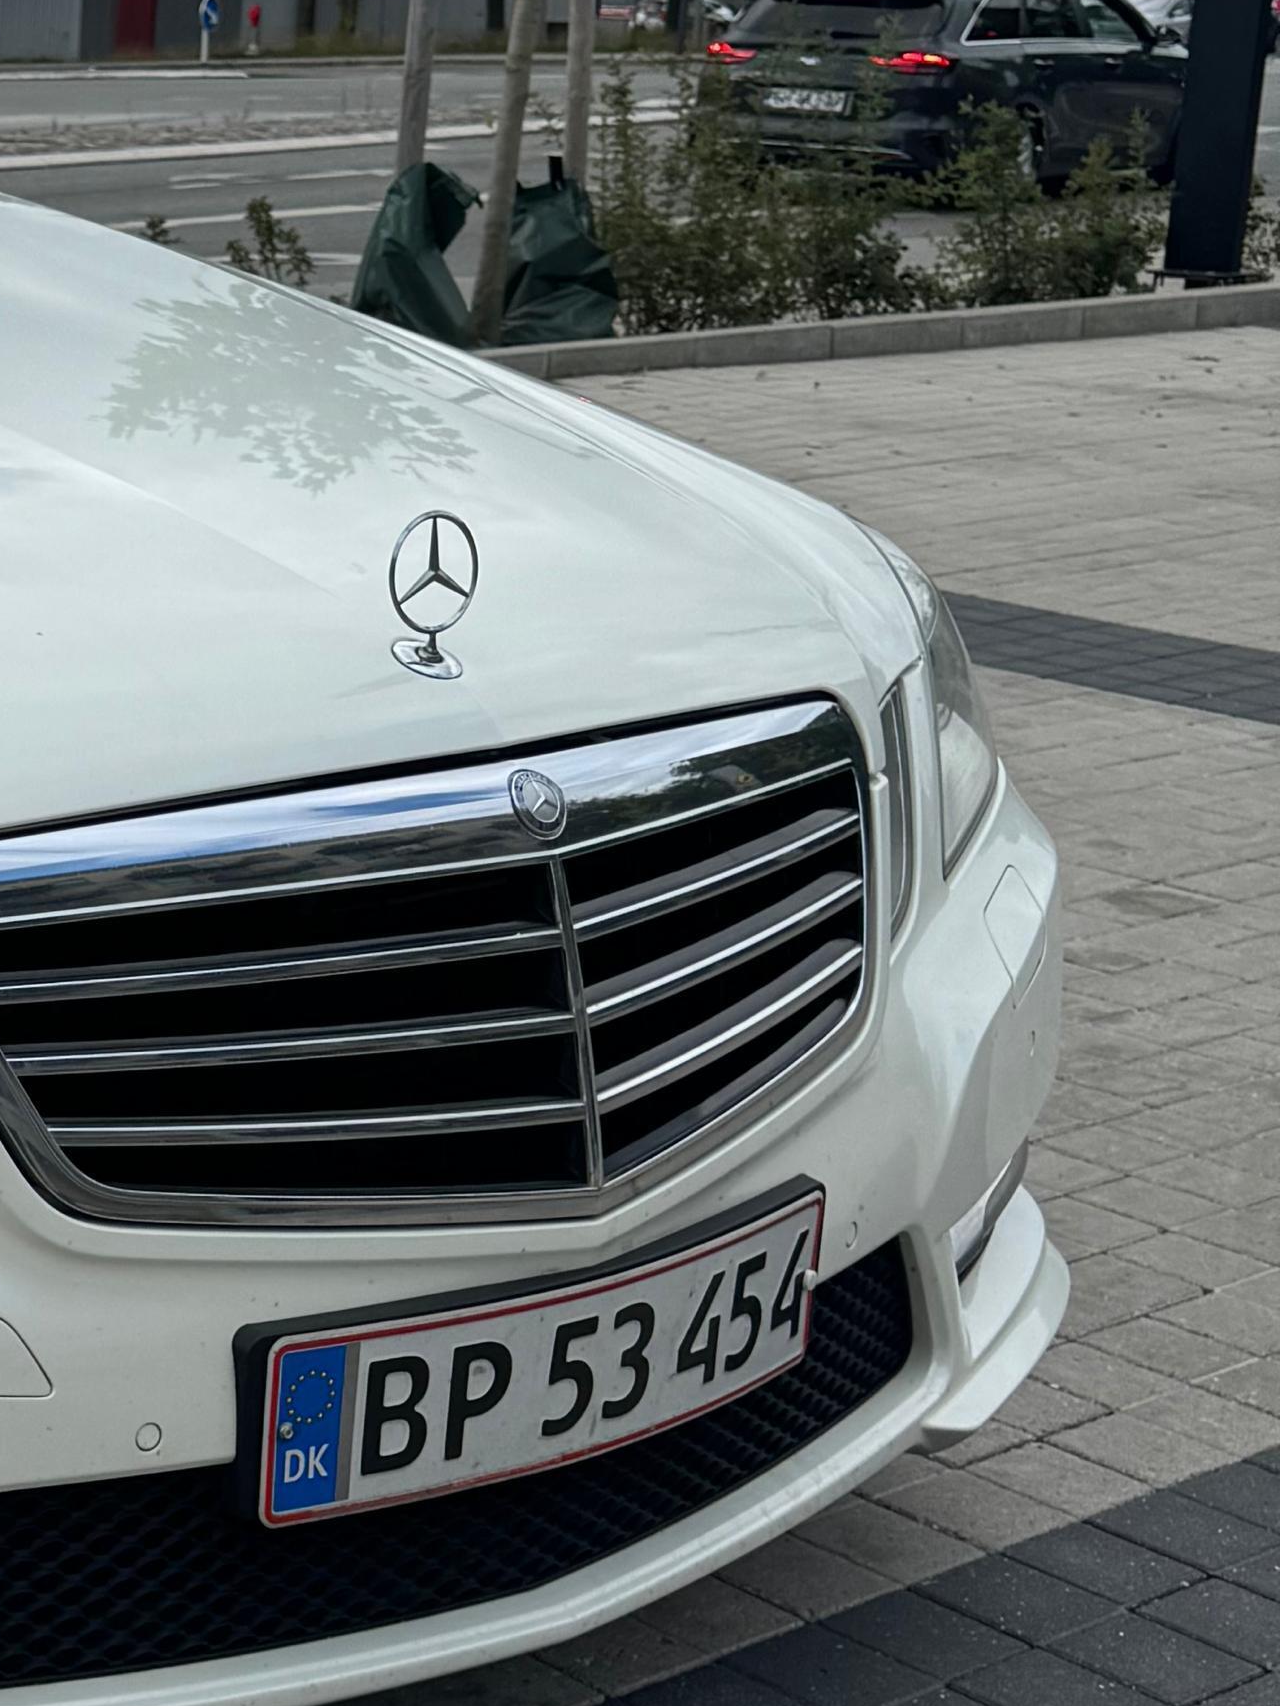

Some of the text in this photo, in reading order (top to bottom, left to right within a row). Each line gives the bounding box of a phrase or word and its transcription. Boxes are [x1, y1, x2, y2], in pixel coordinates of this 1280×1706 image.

[360, 1229, 811, 1476] BP 53 454
[283, 1443, 329, 1484] DK
